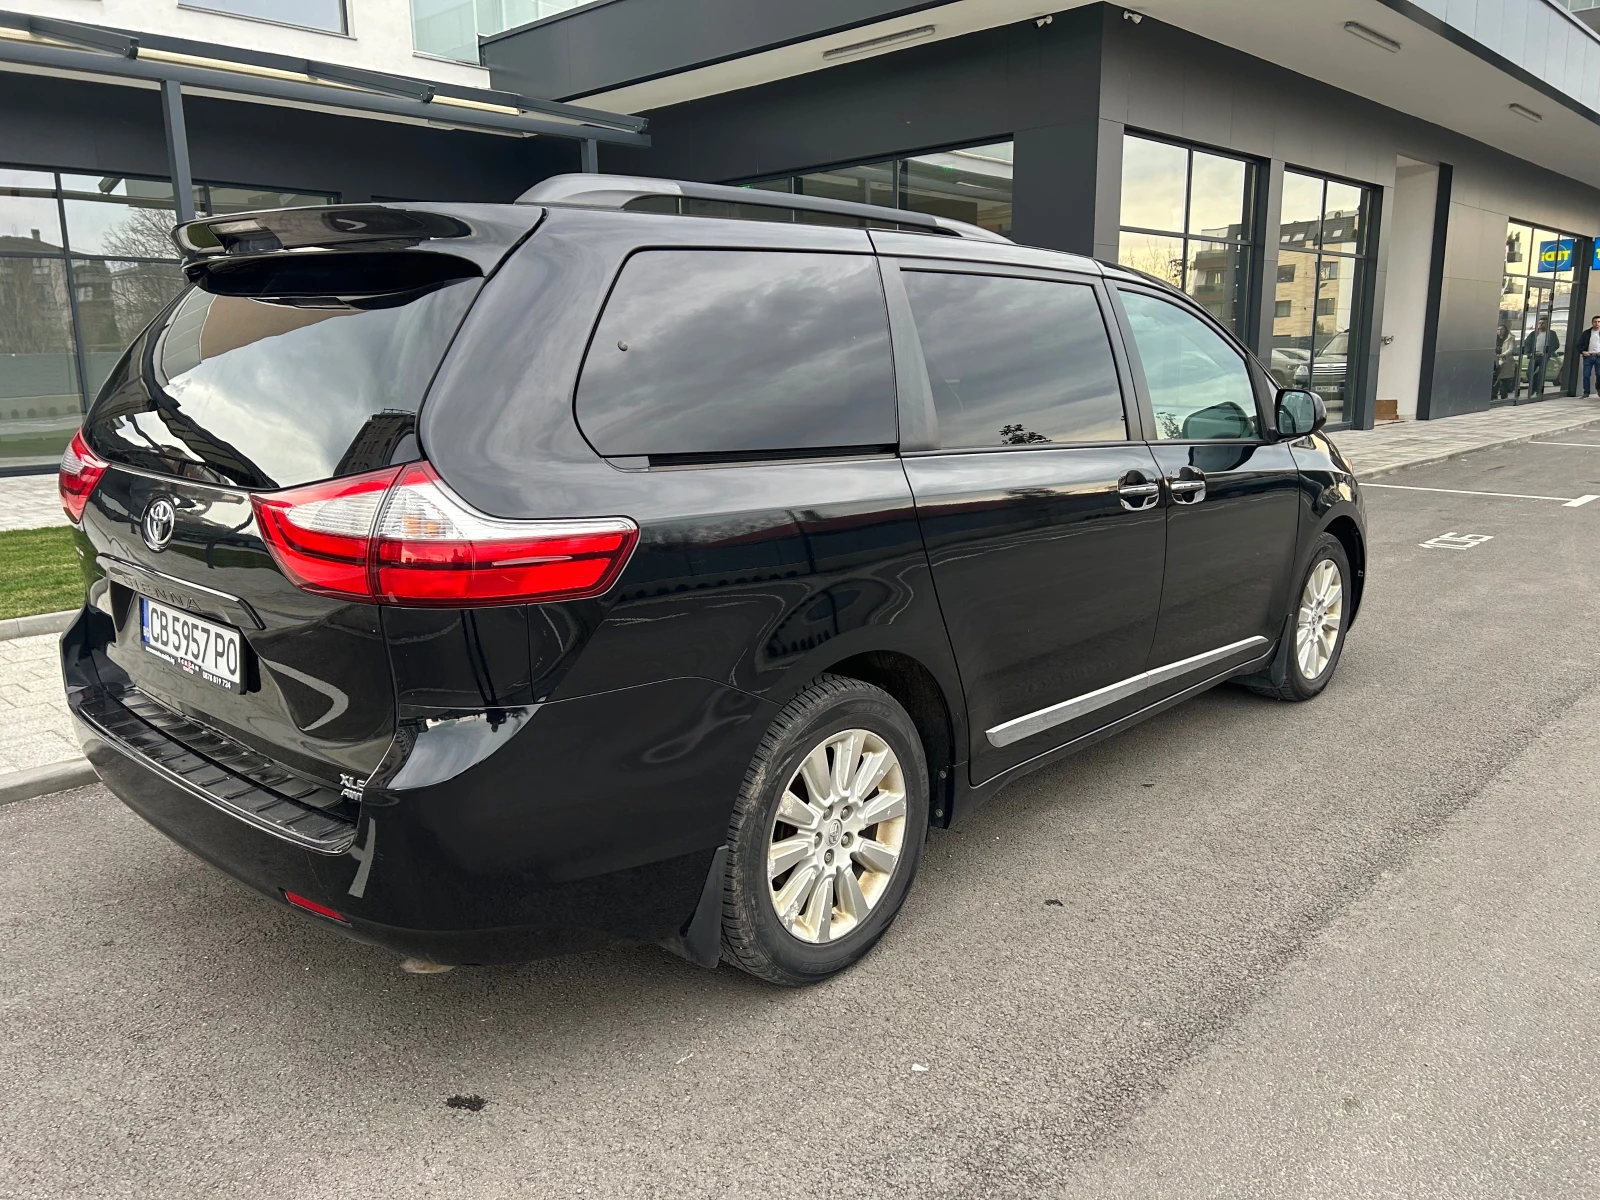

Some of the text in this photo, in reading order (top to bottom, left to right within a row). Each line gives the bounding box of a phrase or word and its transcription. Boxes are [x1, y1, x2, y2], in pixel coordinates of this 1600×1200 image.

[122, 573, 203, 612] SIENNA
[150, 607, 169, 647] CB
[172, 616, 211, 664] 5957
[339, 773, 365, 790] XLE
